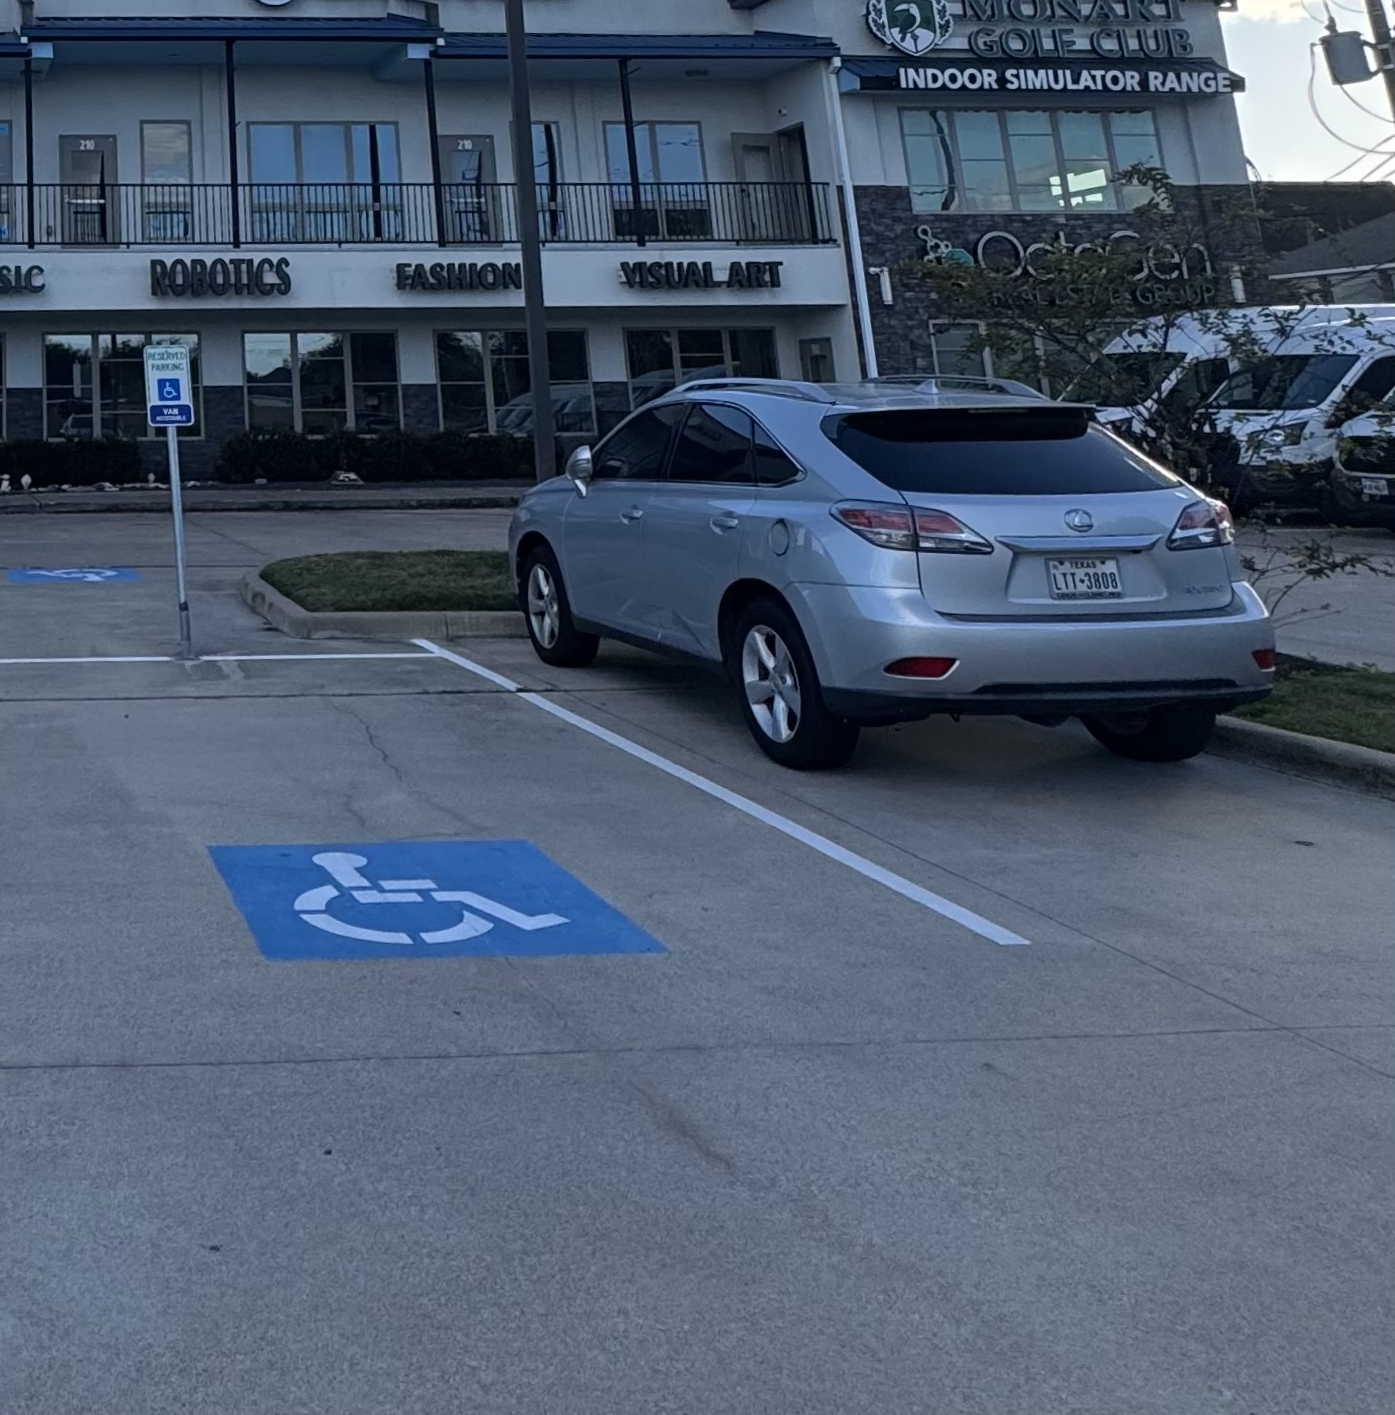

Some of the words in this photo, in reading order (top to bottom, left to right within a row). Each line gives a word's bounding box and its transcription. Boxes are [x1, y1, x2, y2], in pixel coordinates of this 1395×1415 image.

[968, 27, 1076, 58] GOLF
[1090, 28, 1195, 58] CLUB
[899, 68, 999, 90] INDOOR
[1004, 69, 1141, 92] SIMULATOR
[1148, 70, 1232, 93] RANGE
[79, 139, 95, 150] 210
[457, 139, 473, 150] 210
[150, 258, 291, 296] ROBOTICS
[396, 263, 522, 290] FASHION
[620, 261, 723, 288] VISUAL
[726, 261, 783, 288] ART
[148, 352, 186, 360] RESERVED
[151, 363, 184, 371] PARKING
[1069, 561, 1096, 569] TEXAS
